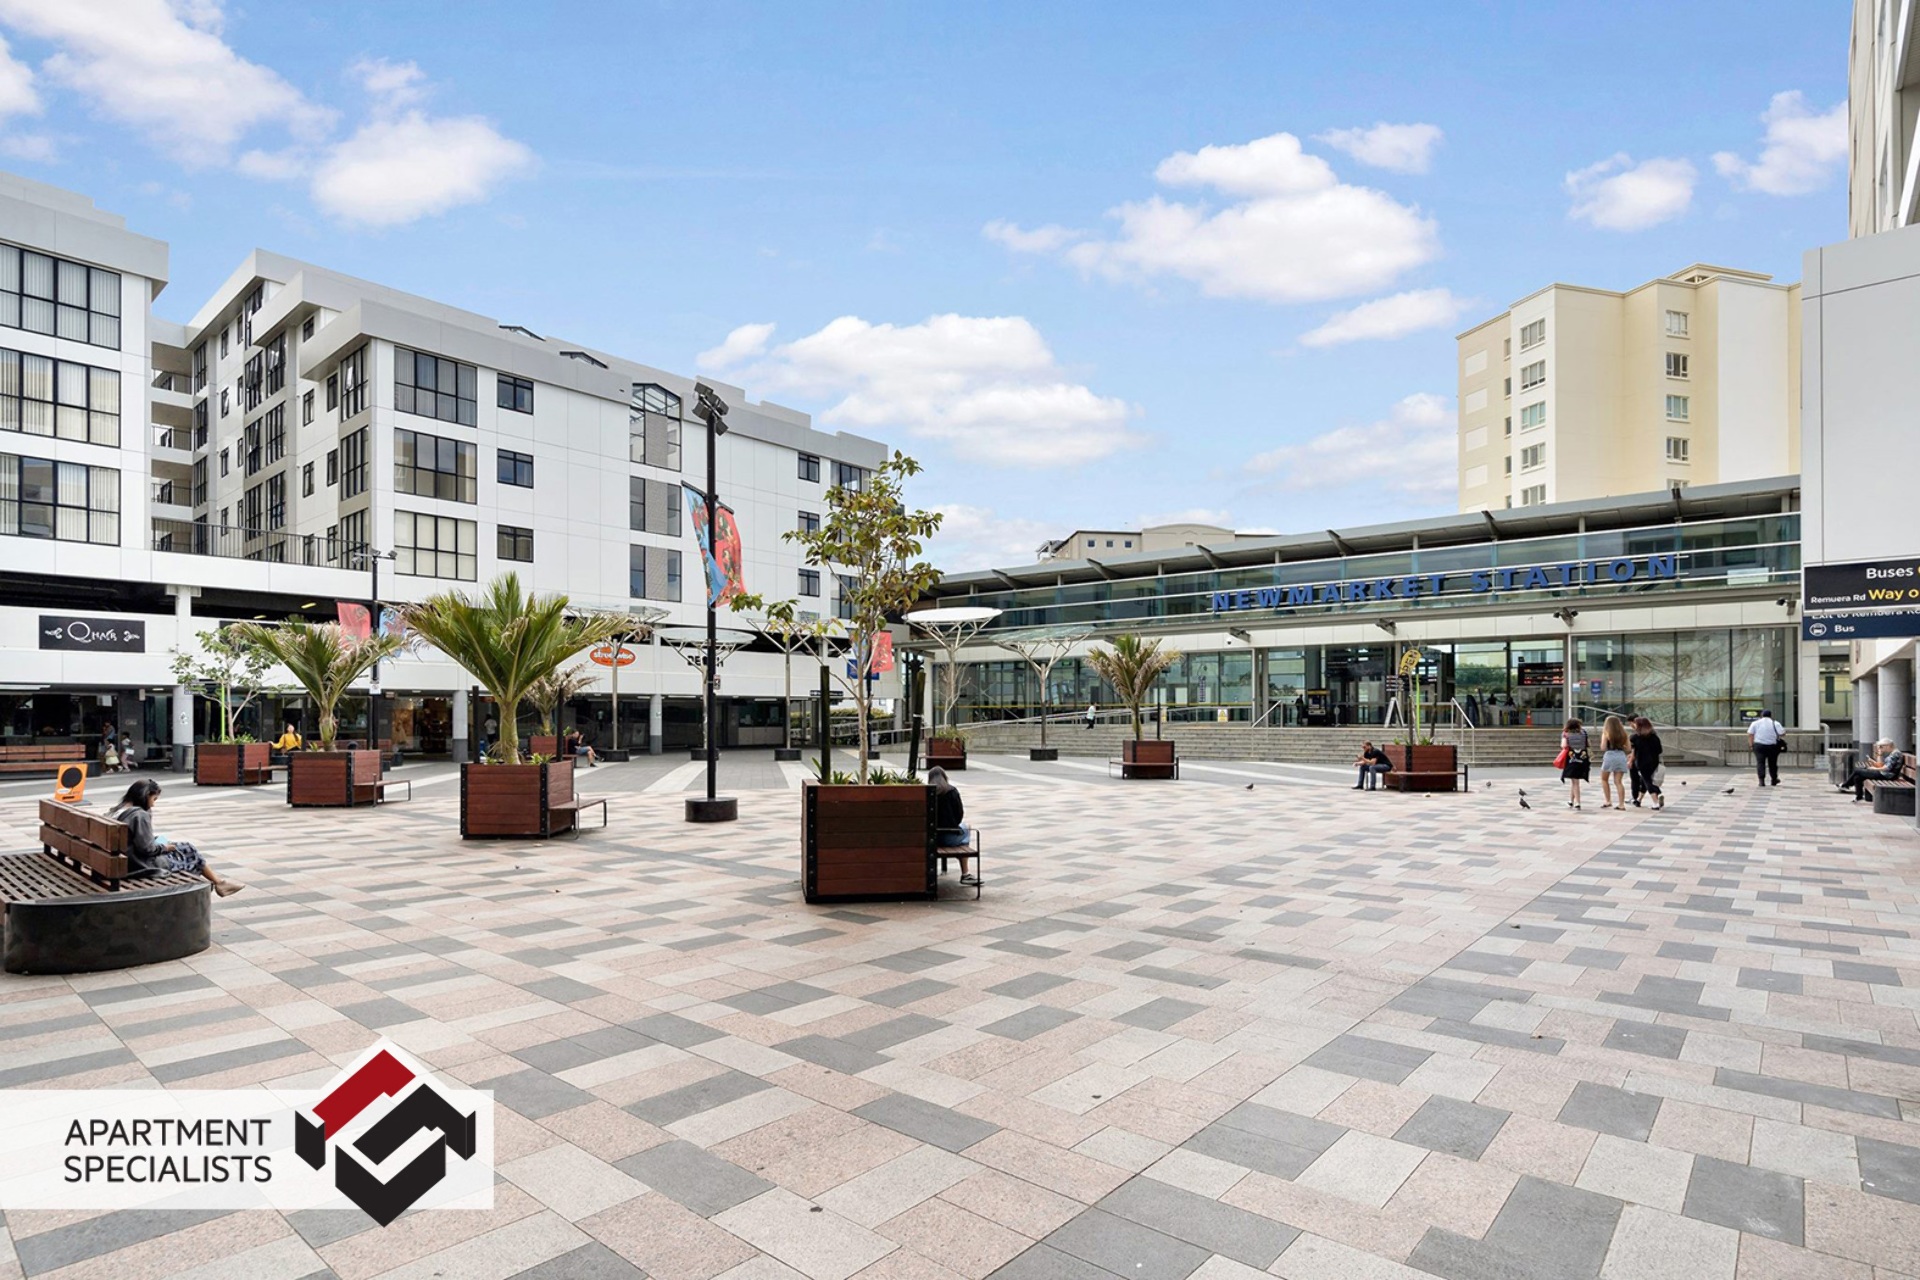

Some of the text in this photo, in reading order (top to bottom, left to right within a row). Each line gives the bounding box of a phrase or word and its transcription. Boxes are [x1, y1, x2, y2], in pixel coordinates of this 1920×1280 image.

[1866, 567, 1914, 579] Buses
[1213, 554, 1675, 612] NEWMARKET STATION
[1811, 593, 1866, 604] Remuera Rd
[1868, 588, 1905, 602] Way
[1834, 624, 1855, 633] Bus
